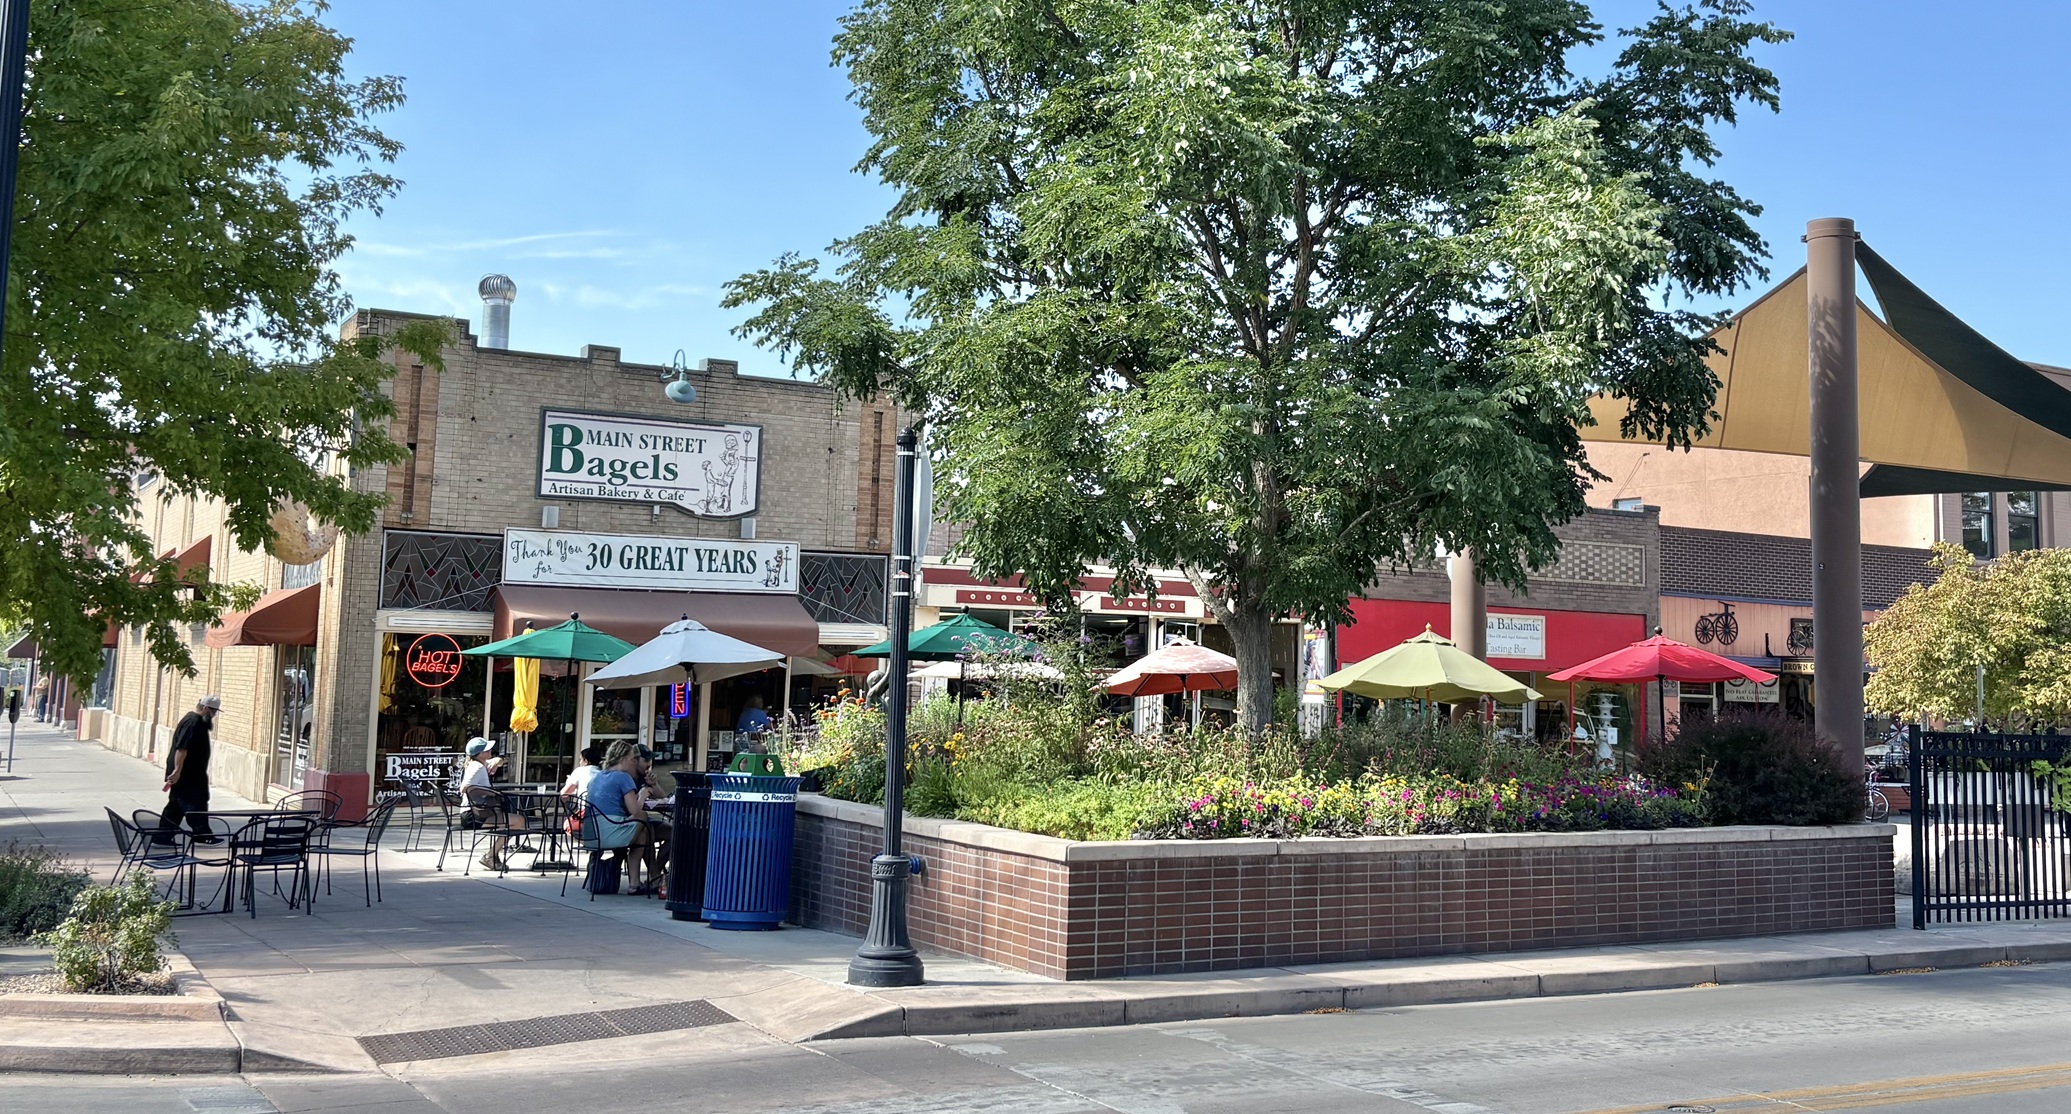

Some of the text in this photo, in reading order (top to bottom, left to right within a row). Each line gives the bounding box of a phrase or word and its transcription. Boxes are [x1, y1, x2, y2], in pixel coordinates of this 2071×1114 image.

[586, 429, 707, 454] MAIN STREET
[546, 424, 679, 486] Bagels
[549, 483, 594, 496] Artisan
[598, 485, 640, 500] Bakery
[643, 488, 654, 500] &
[511, 538, 583, 563] Thank You
[586, 542, 757, 575] 30 GREAT YEARS
[533, 561, 553, 579] for
[1497, 618, 1540, 631] Balsamic
[1486, 643, 1526, 654] Tasting Bar
[412, 650, 457, 673] HOT BAGELS
[675, 682, 685, 713] PEN
[384, 756, 441, 780] Bagels
[401, 757, 453, 765] MAIN STREET
[771, 793, 793, 802] Recycle
